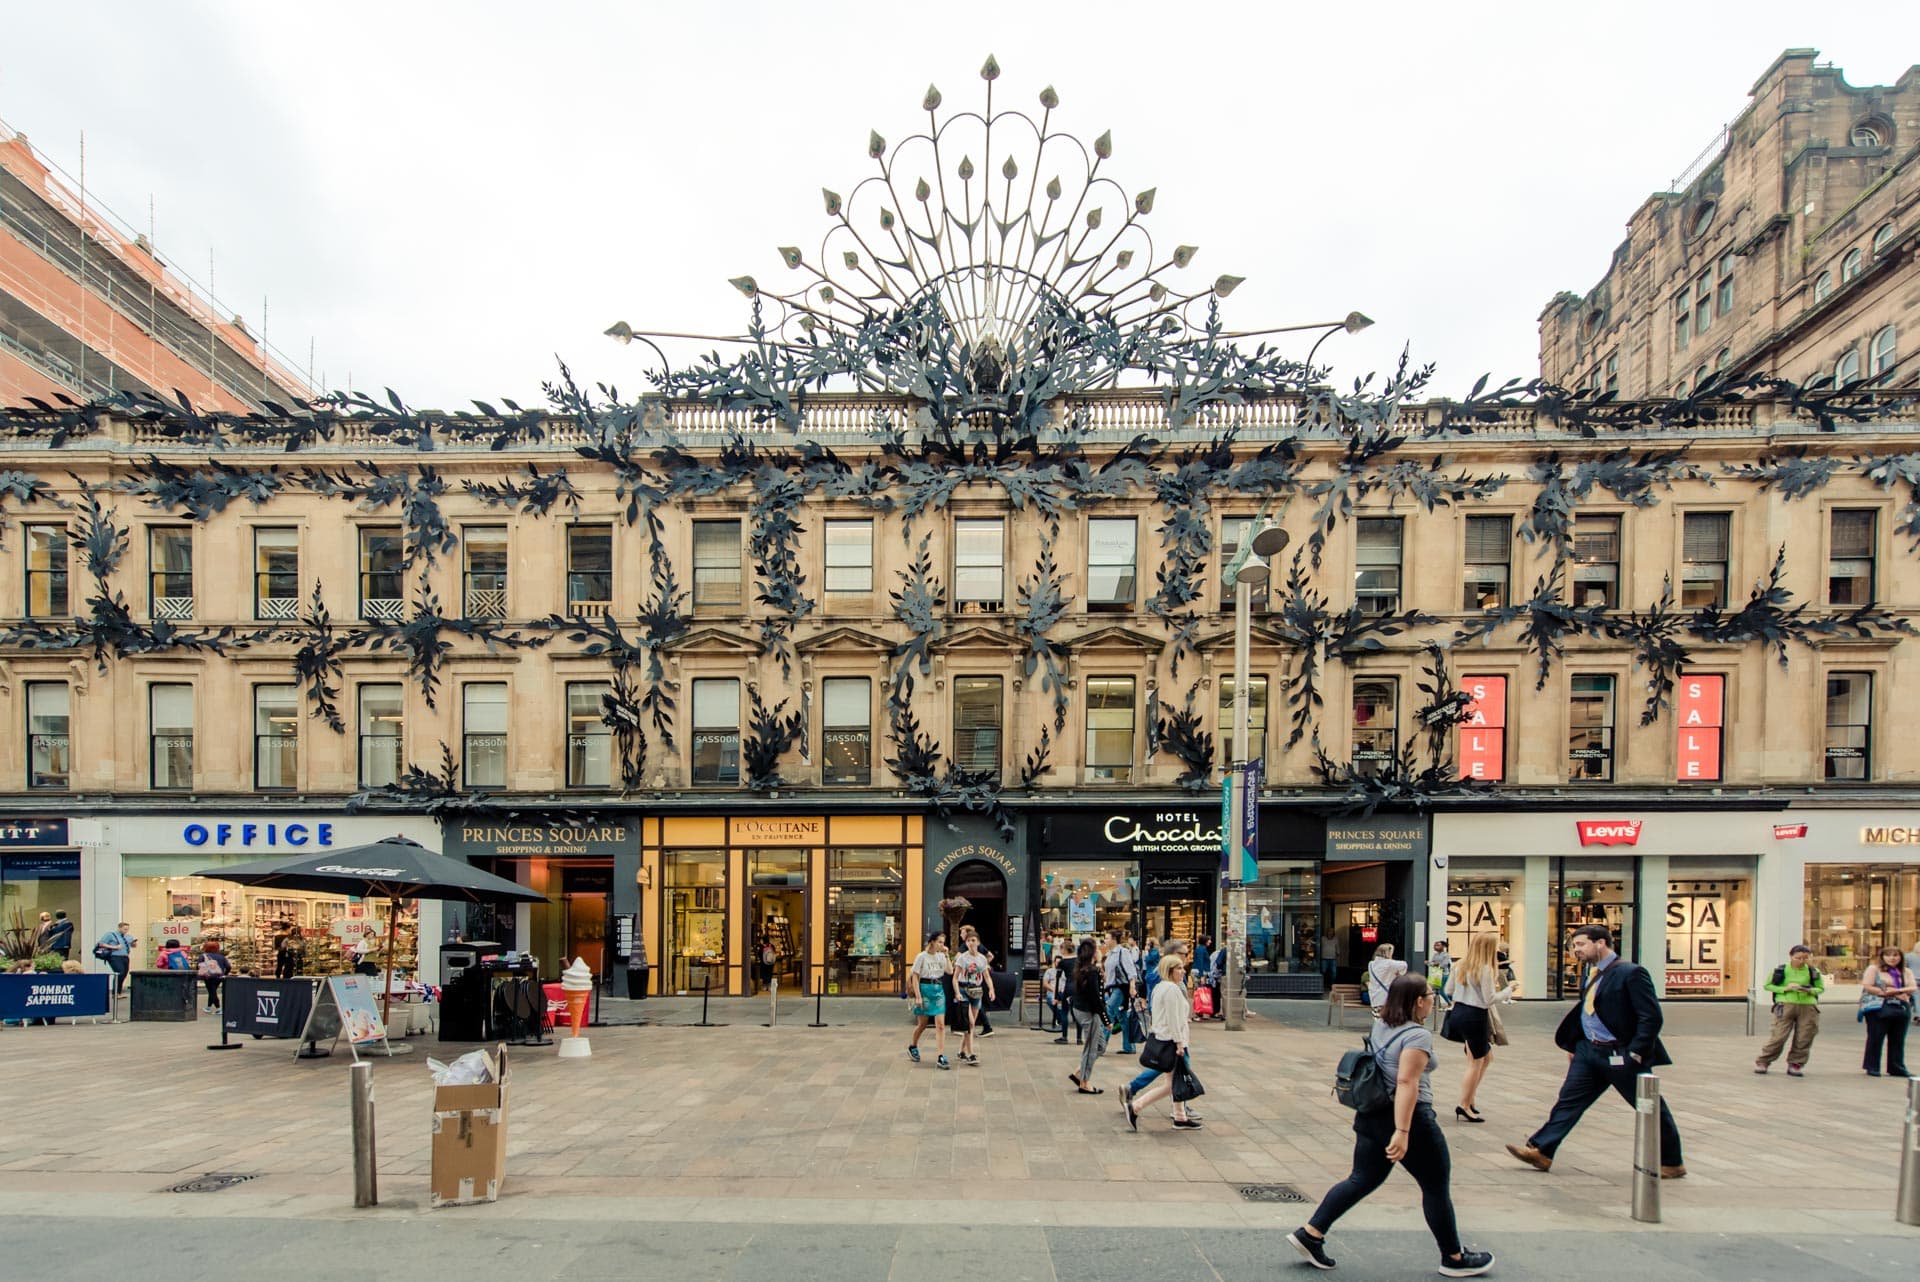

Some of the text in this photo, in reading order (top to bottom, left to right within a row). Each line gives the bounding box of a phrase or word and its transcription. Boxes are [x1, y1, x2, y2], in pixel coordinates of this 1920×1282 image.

[1471, 684, 1487, 778] SALE
[1687, 683, 1703, 777] SALE
[696, 735, 739, 744] SASSOON
[826, 735, 869, 743] SASSOON
[1156, 813, 1199, 822] HOTEL
[184, 823, 334, 846] OFFICE
[462, 828, 626, 844] PRINCES SQUARE
[1328, 831, 1424, 840] PRINCES SQUARE
[496, 846, 587, 854] SHOPPING & DINING
[934, 845, 1017, 876] PRINCES SQUARE
[163, 924, 189, 935] sale
[345, 921, 371, 932] sale
[1694, 974, 1719, 984] 50%
[31, 984, 75, 995] BOMBAY
[25, 994, 75, 1007] SAPPHIRE
[256, 997, 280, 1017] NY
